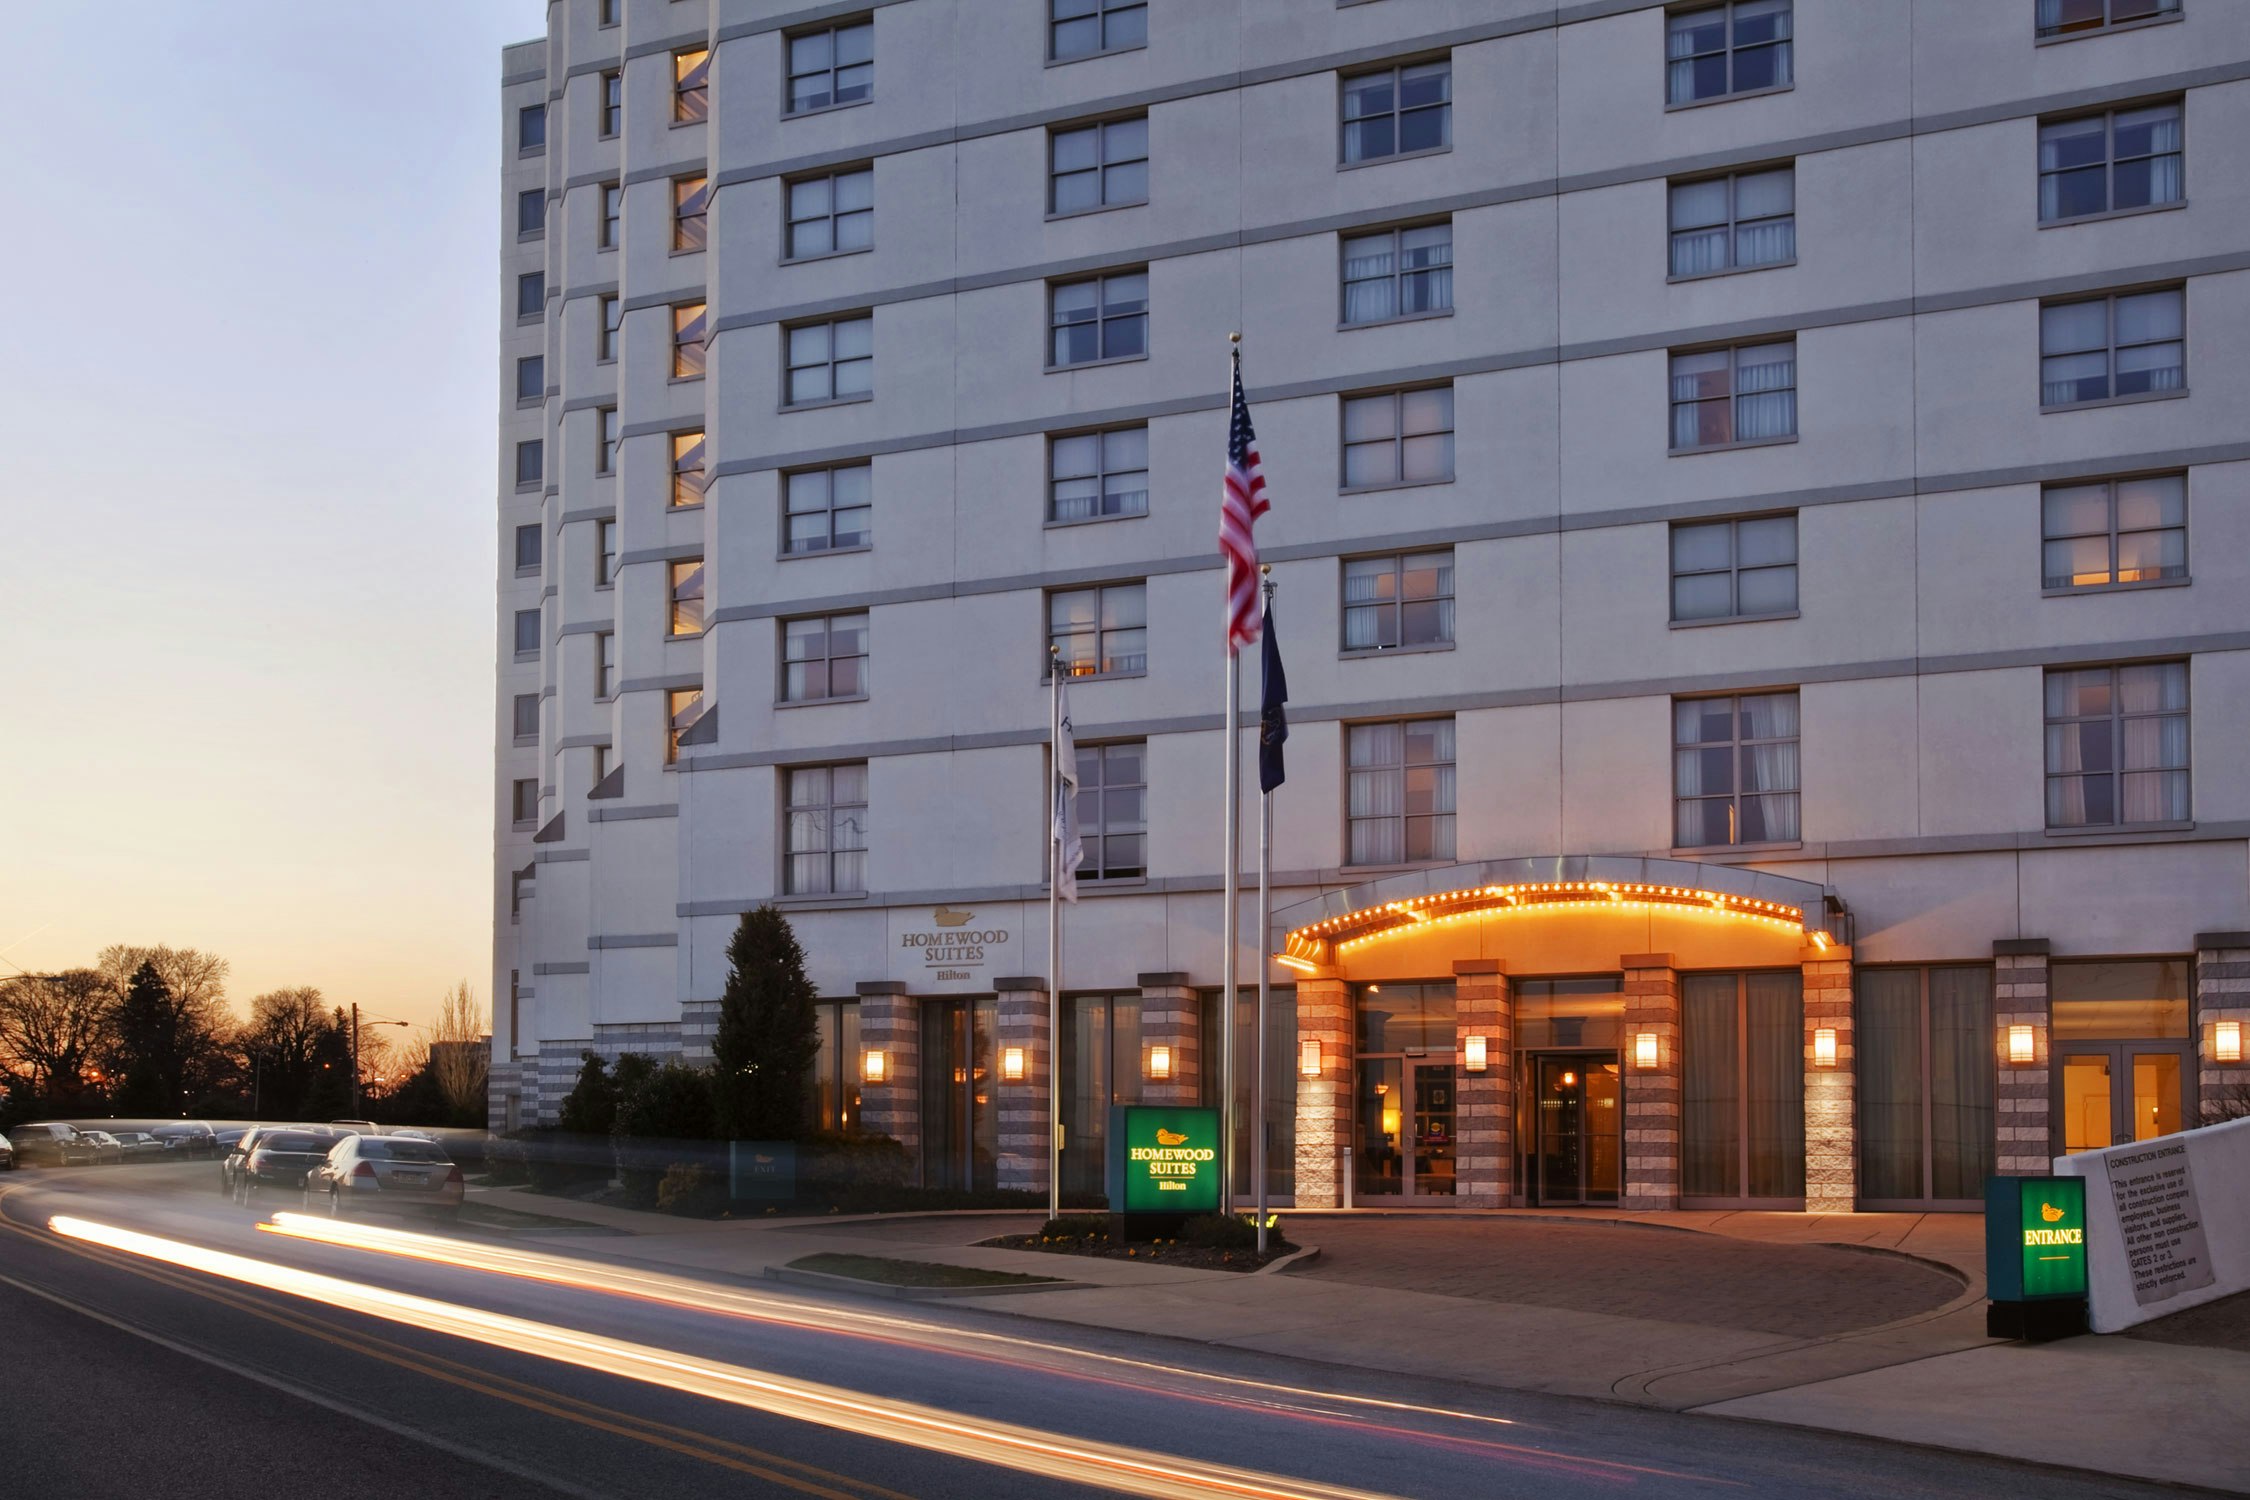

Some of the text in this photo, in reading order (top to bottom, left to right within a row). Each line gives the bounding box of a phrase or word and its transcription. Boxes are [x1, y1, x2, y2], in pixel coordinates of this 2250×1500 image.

[902, 930, 1009, 947] HOMEWOOD
[925, 946, 984, 961] SUITES
[936, 969, 970, 981] Hilton
[1130, 1148, 1214, 1161] HOMEWOOD
[2110, 1145, 2186, 1168] CONSTRUCTION ENTRANCE
[1150, 1162, 1196, 1175] SUITES
[1159, 1181, 1186, 1190] Hilton
[2114, 1180, 2127, 1190] This
[2129, 1174, 2154, 1185] entrance
[2163, 1166, 2185, 1178] reserved
[2116, 1190, 2126, 1200] for
[2128, 1188, 2138, 1197] the
[2140, 1183, 2165, 1195] exclusive
[2167, 1181, 2176, 1189] use
[2119, 1190, 2189, 1212] all construction company
[2156, 1202, 2180, 1214] business
[2150, 1218, 2160, 1228] and
[2024, 1229, 2082, 1245] ENTRANCE
[2137, 1233, 2152, 1242] other
[2167, 1221, 2198, 1236] construction
[2129, 1237, 2181, 1258] persons must use
[2131, 1255, 2152, 1268] GATES
[2153, 1254, 2158, 1262] 2
[2134, 1268, 2152, 1280] These
[2188, 1256, 2196, 1265] are
[2136, 1277, 2158, 1291] strictly
